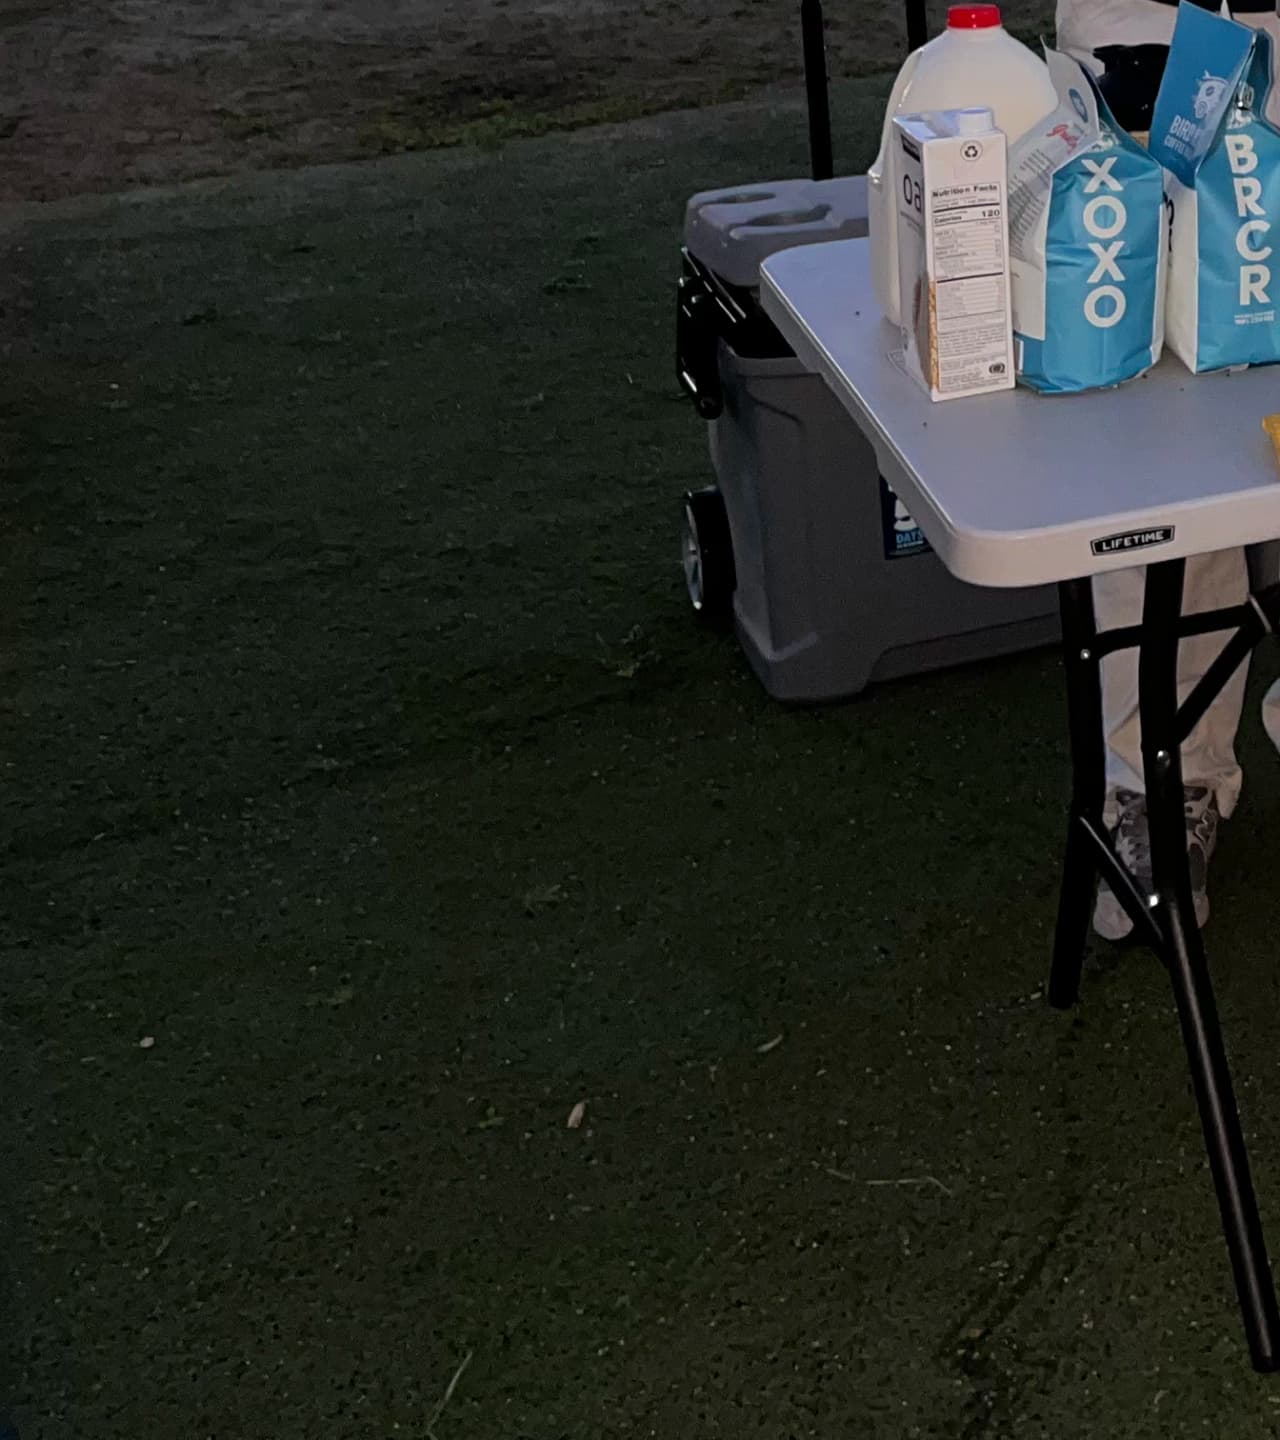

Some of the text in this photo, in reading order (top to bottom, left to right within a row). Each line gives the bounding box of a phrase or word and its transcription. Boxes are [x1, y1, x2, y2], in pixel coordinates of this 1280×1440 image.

[981, 209, 1001, 218] 120
[1081, 156, 1127, 328] XOXO
[1224, 133, 1273, 306] BRCR
[1102, 530, 1165, 551] LIFETIME
